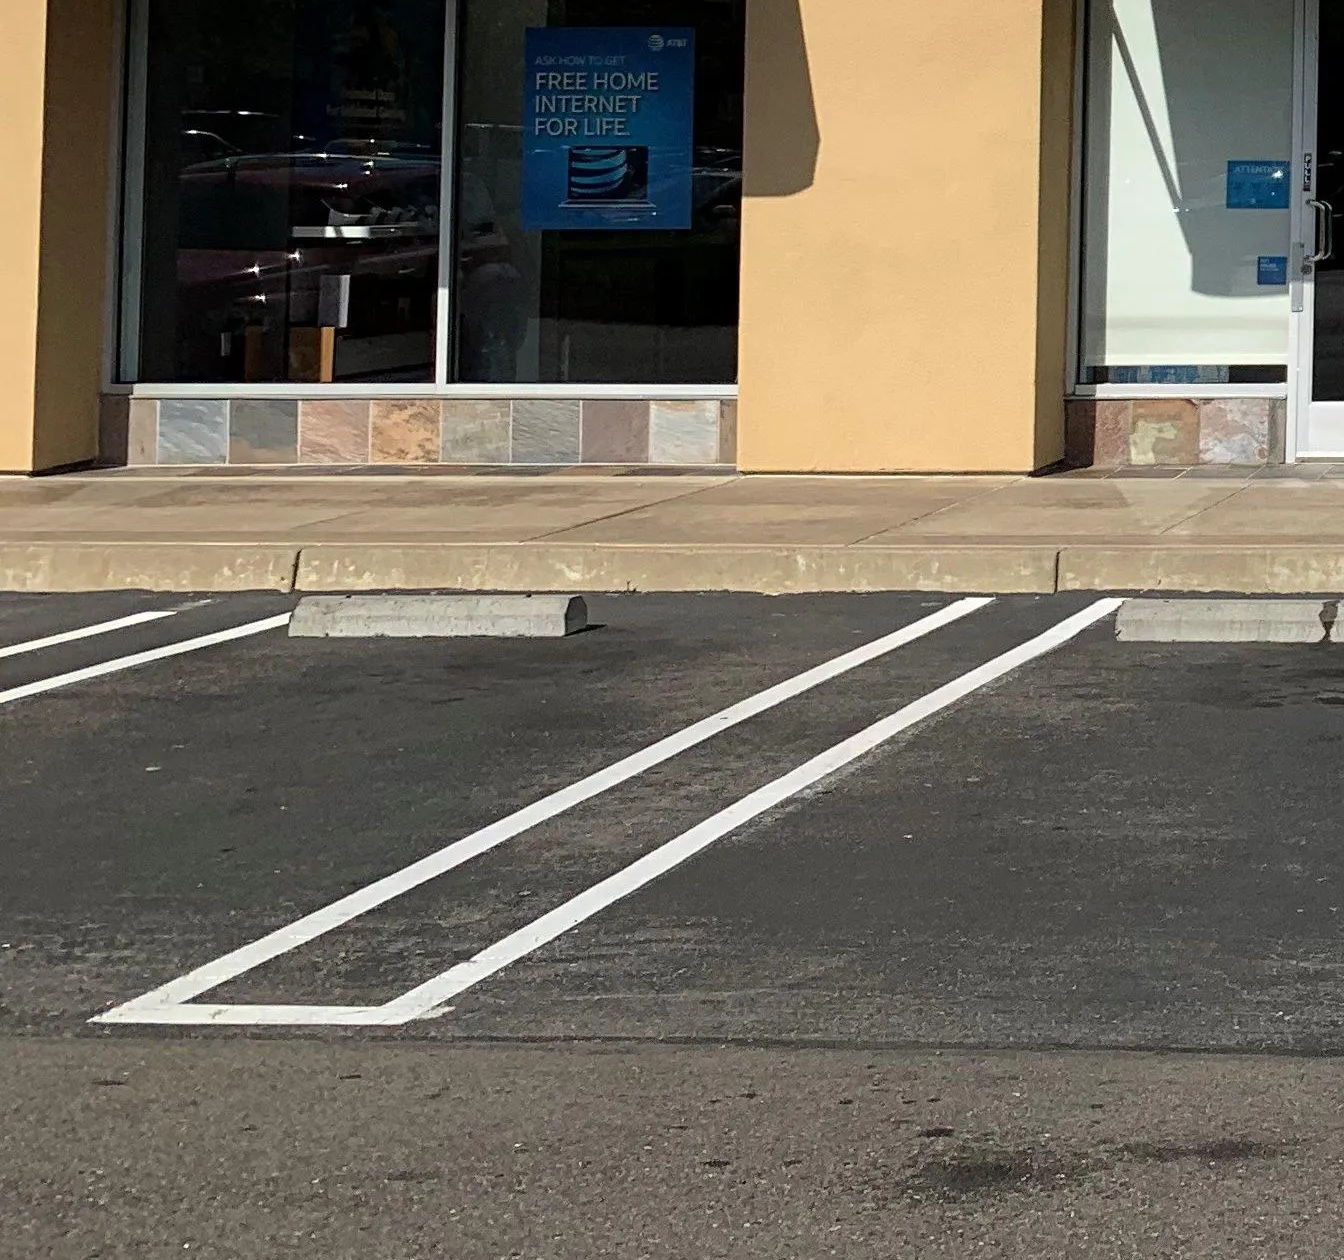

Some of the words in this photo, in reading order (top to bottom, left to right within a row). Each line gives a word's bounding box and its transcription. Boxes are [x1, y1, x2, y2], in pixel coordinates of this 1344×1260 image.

[665, 38, 688, 47] AT&T
[534, 55, 556, 66] ASK
[558, 55, 586, 66] HOW
[587, 55, 603, 66] TO
[604, 55, 627, 66] GET
[535, 72, 587, 91] FREE
[593, 72, 660, 91] HOME
[535, 95, 642, 113] INTERNET
[535, 117, 578, 136] FOR
